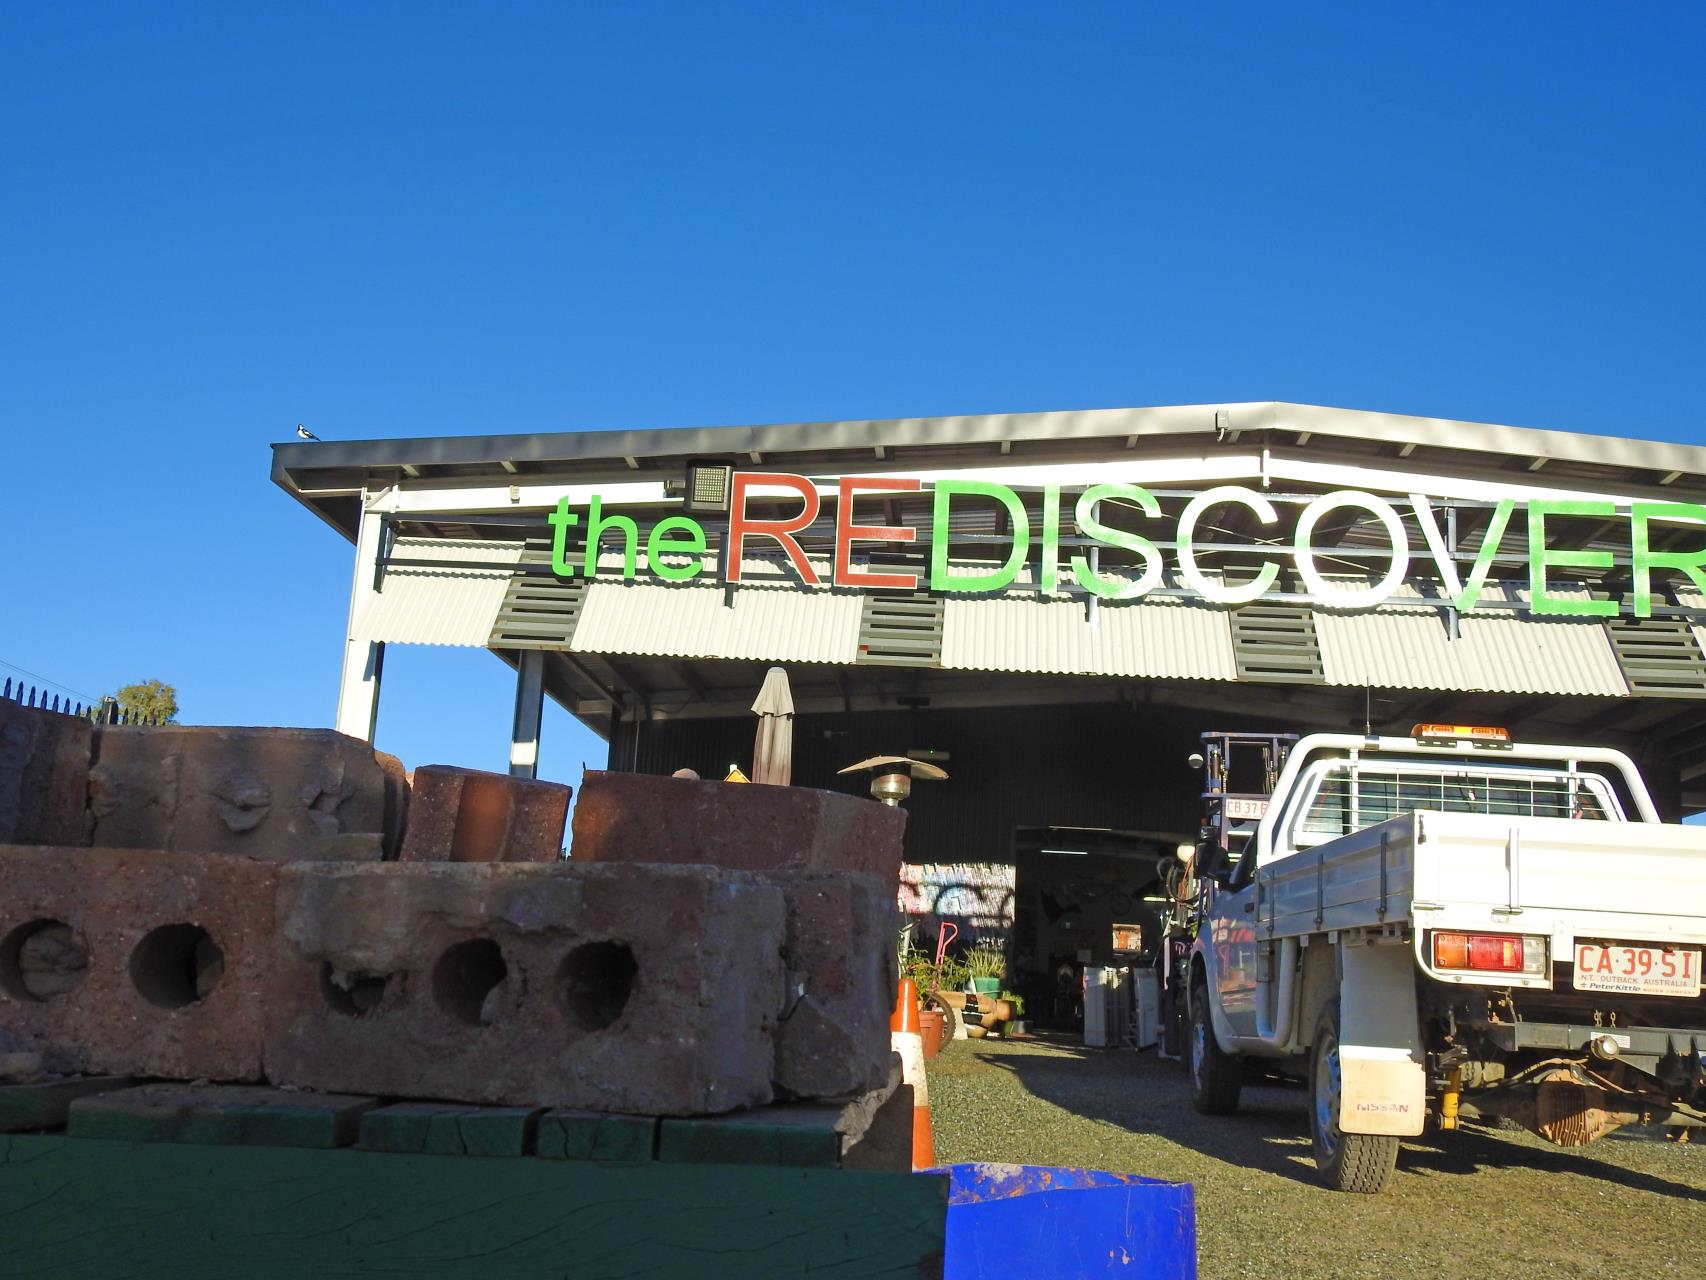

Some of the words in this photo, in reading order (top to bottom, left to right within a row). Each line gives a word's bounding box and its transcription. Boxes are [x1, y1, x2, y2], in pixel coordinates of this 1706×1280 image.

[547, 494, 707, 580] the
[1600, 975, 1638, 985] OUTBACK
[1643, 978, 1688, 988] AUSTRALIA
[1356, 1103, 1409, 1113] NISSAN
